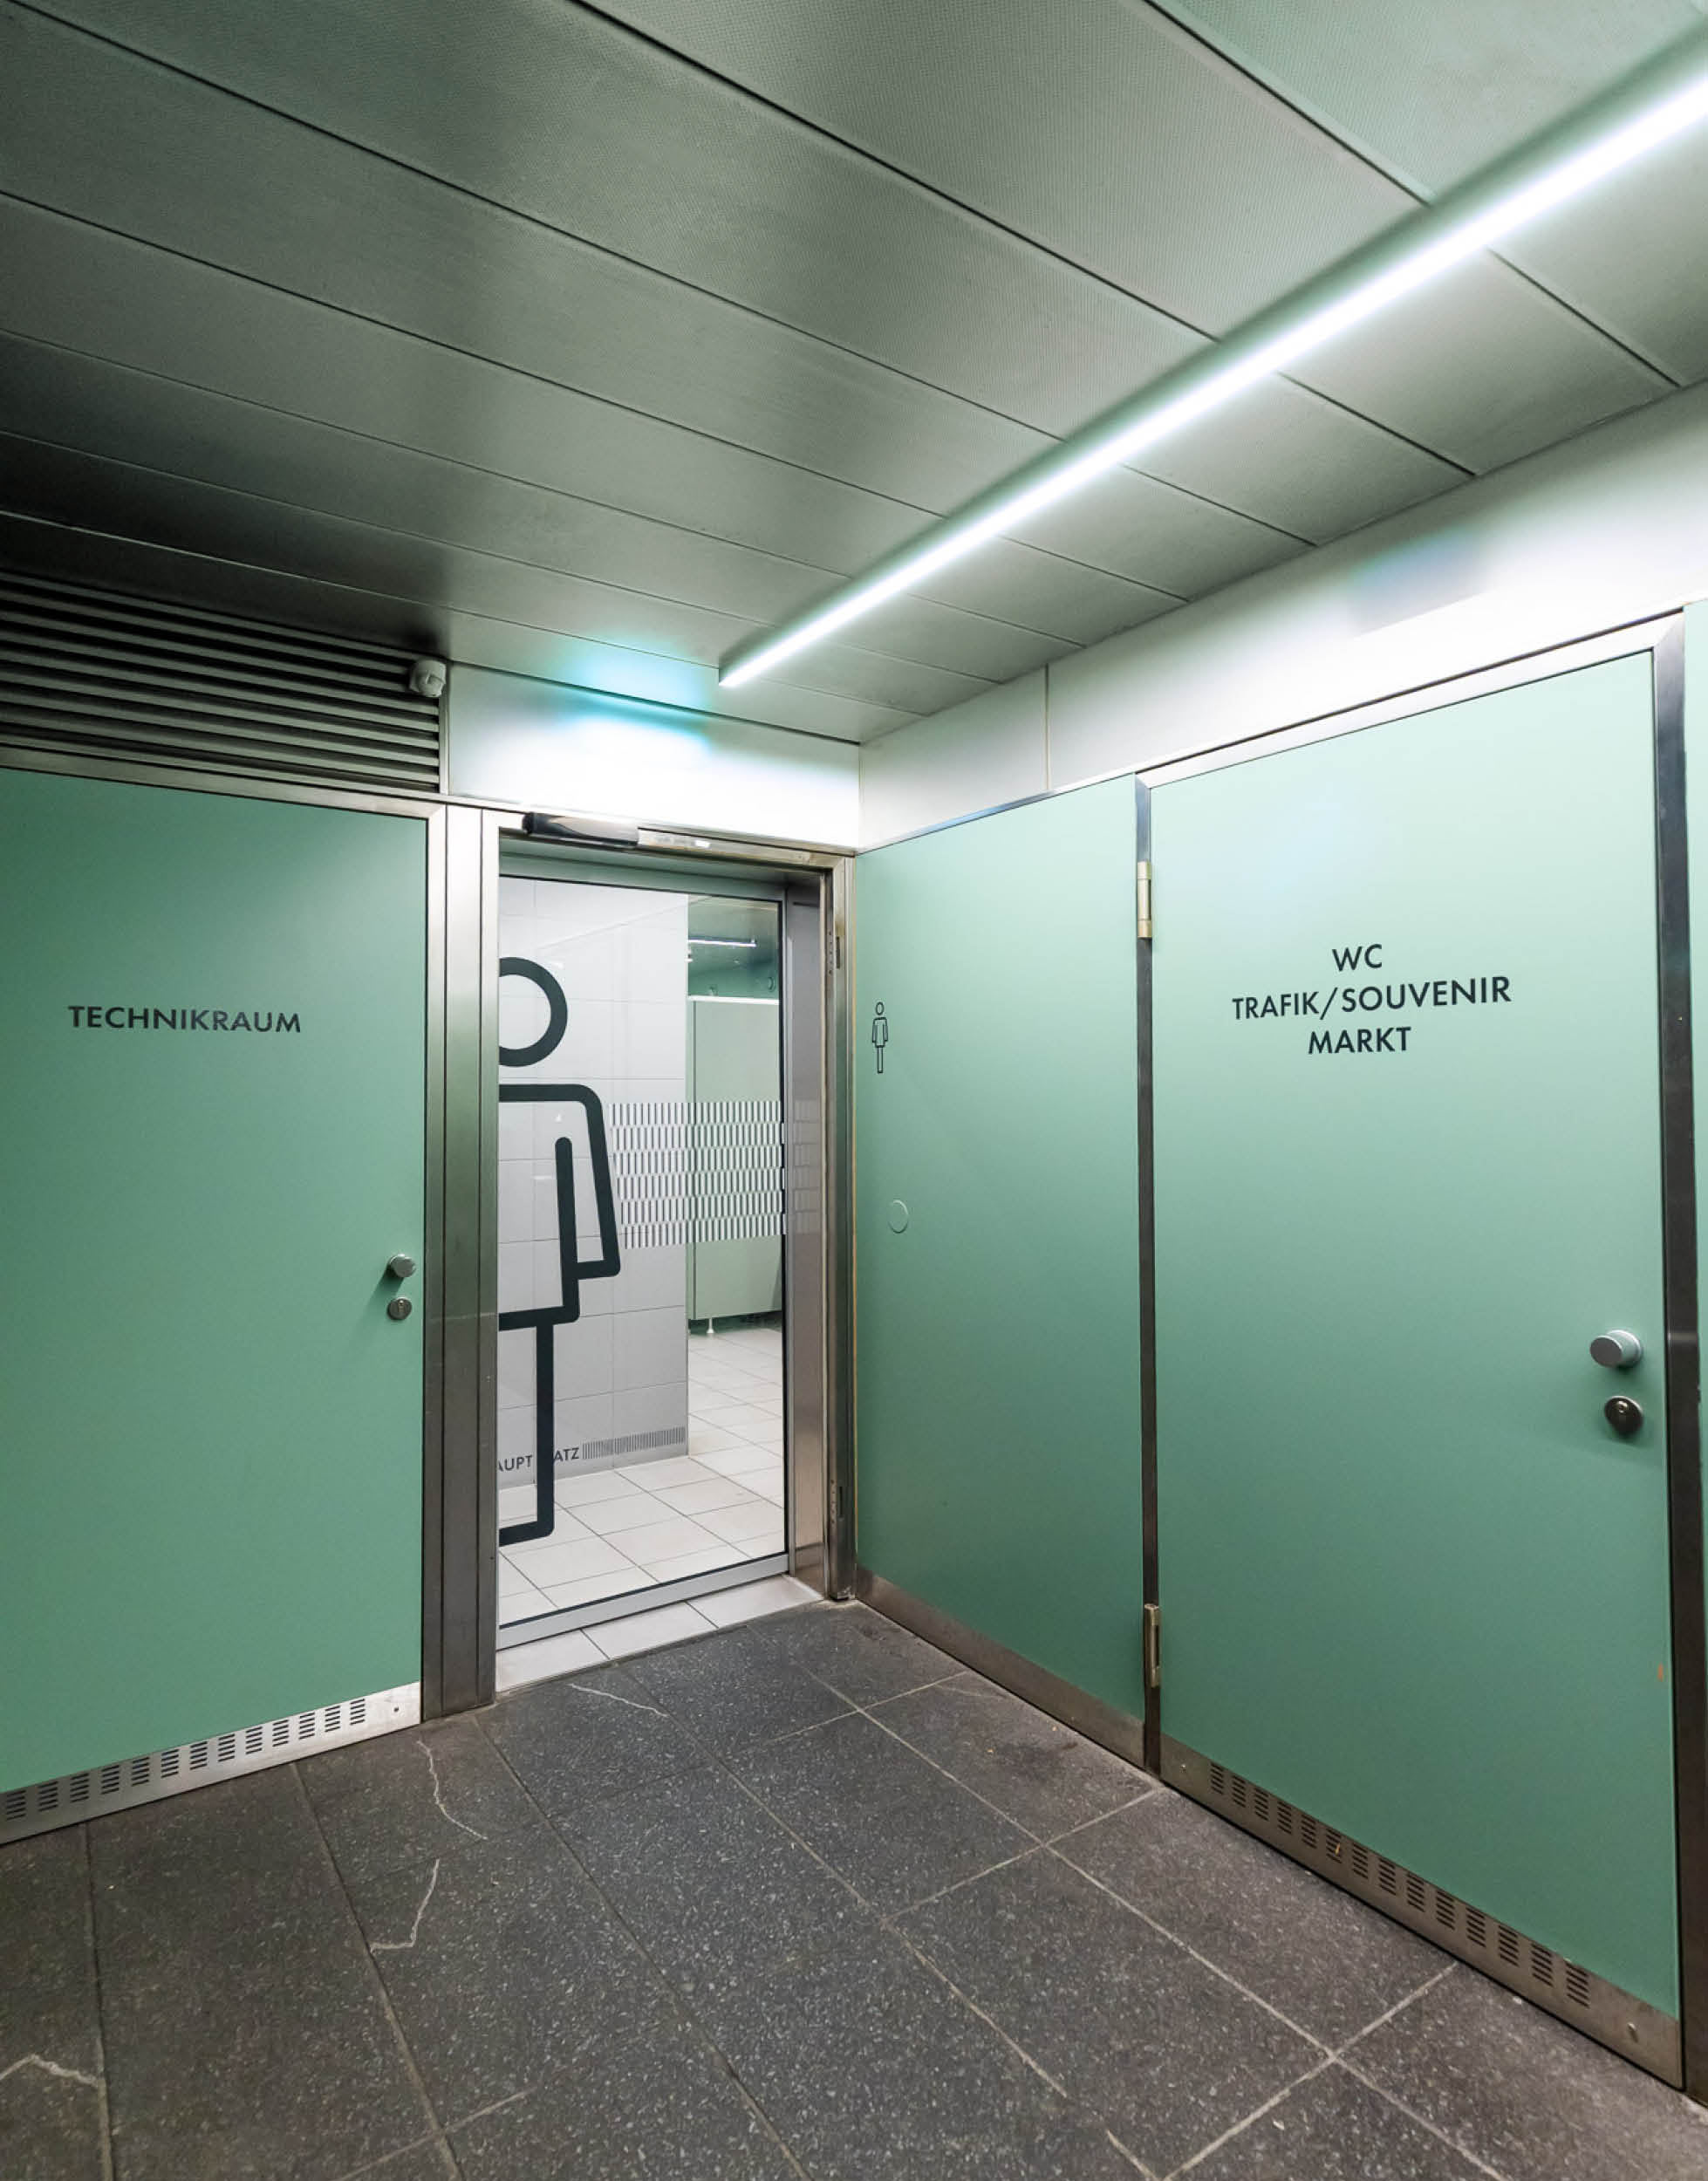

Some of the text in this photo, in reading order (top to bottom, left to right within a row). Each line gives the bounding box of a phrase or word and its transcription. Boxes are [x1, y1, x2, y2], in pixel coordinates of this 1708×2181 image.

[1331, 943, 1383, 972] WC
[1231, 975, 1513, 1021] TRAFIK/SOUVENIR
[67, 1005, 301, 1034] TECHNIKRAUM
[1308, 1026, 1412, 1055] MARKT
